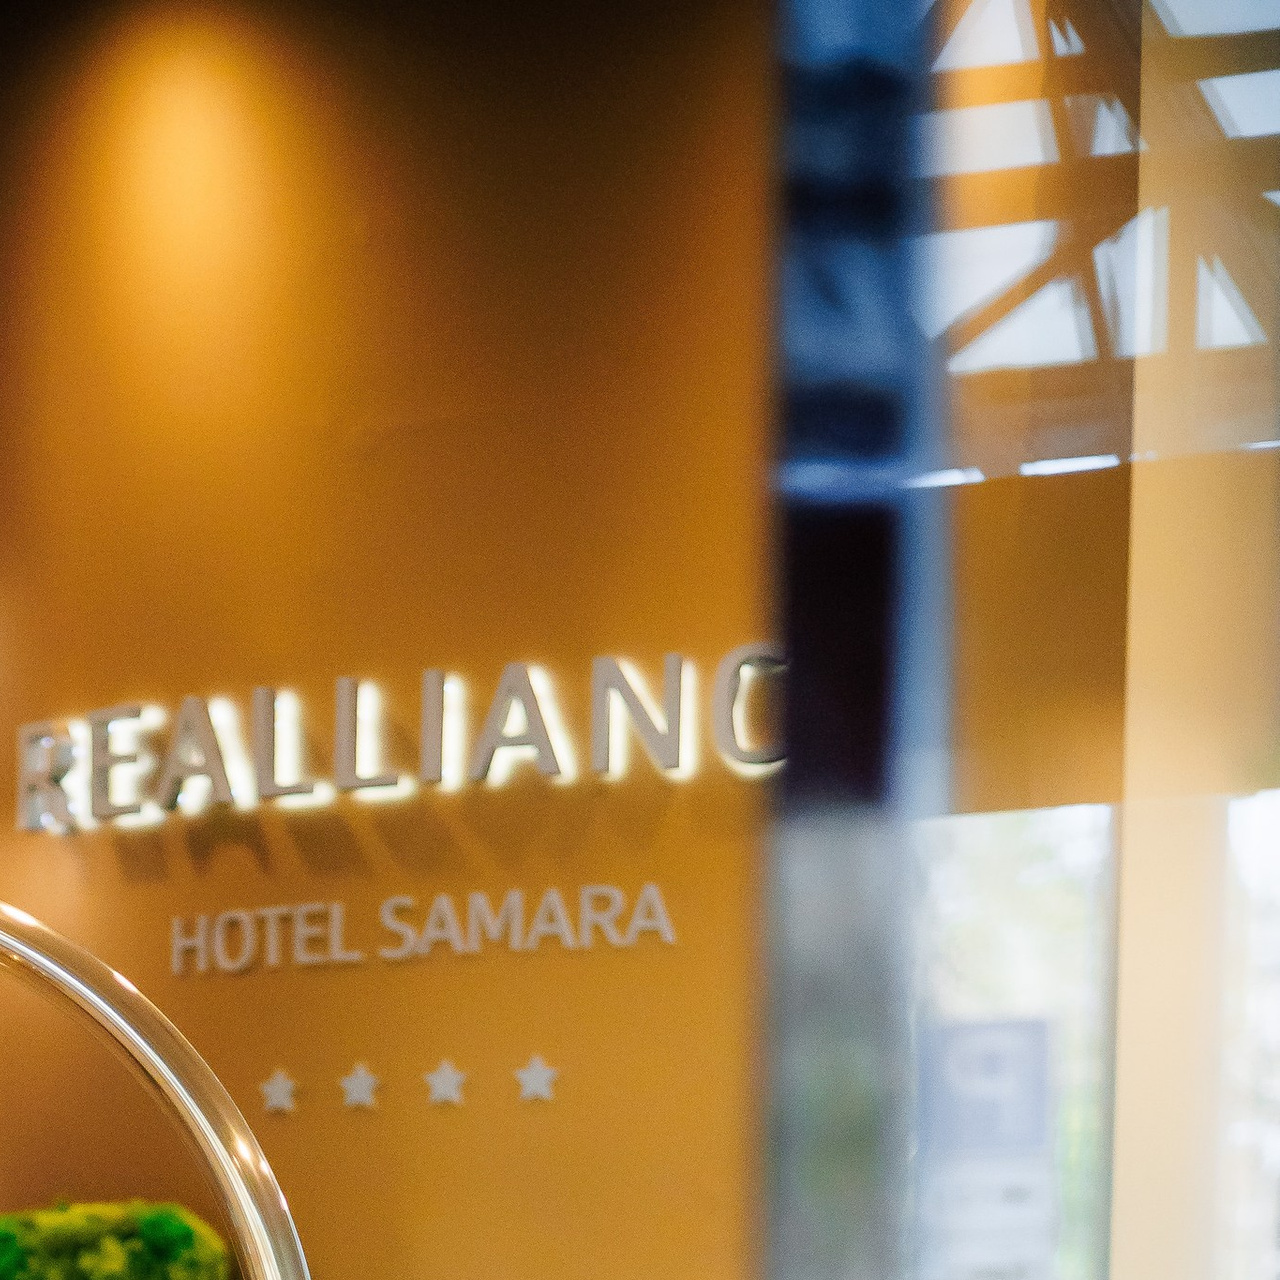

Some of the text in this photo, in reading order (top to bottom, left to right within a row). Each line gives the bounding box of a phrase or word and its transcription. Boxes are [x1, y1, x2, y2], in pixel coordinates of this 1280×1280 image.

[15, 641, 788, 833] REALLIANC
[170, 884, 675, 976] HOTEL SAMARA
